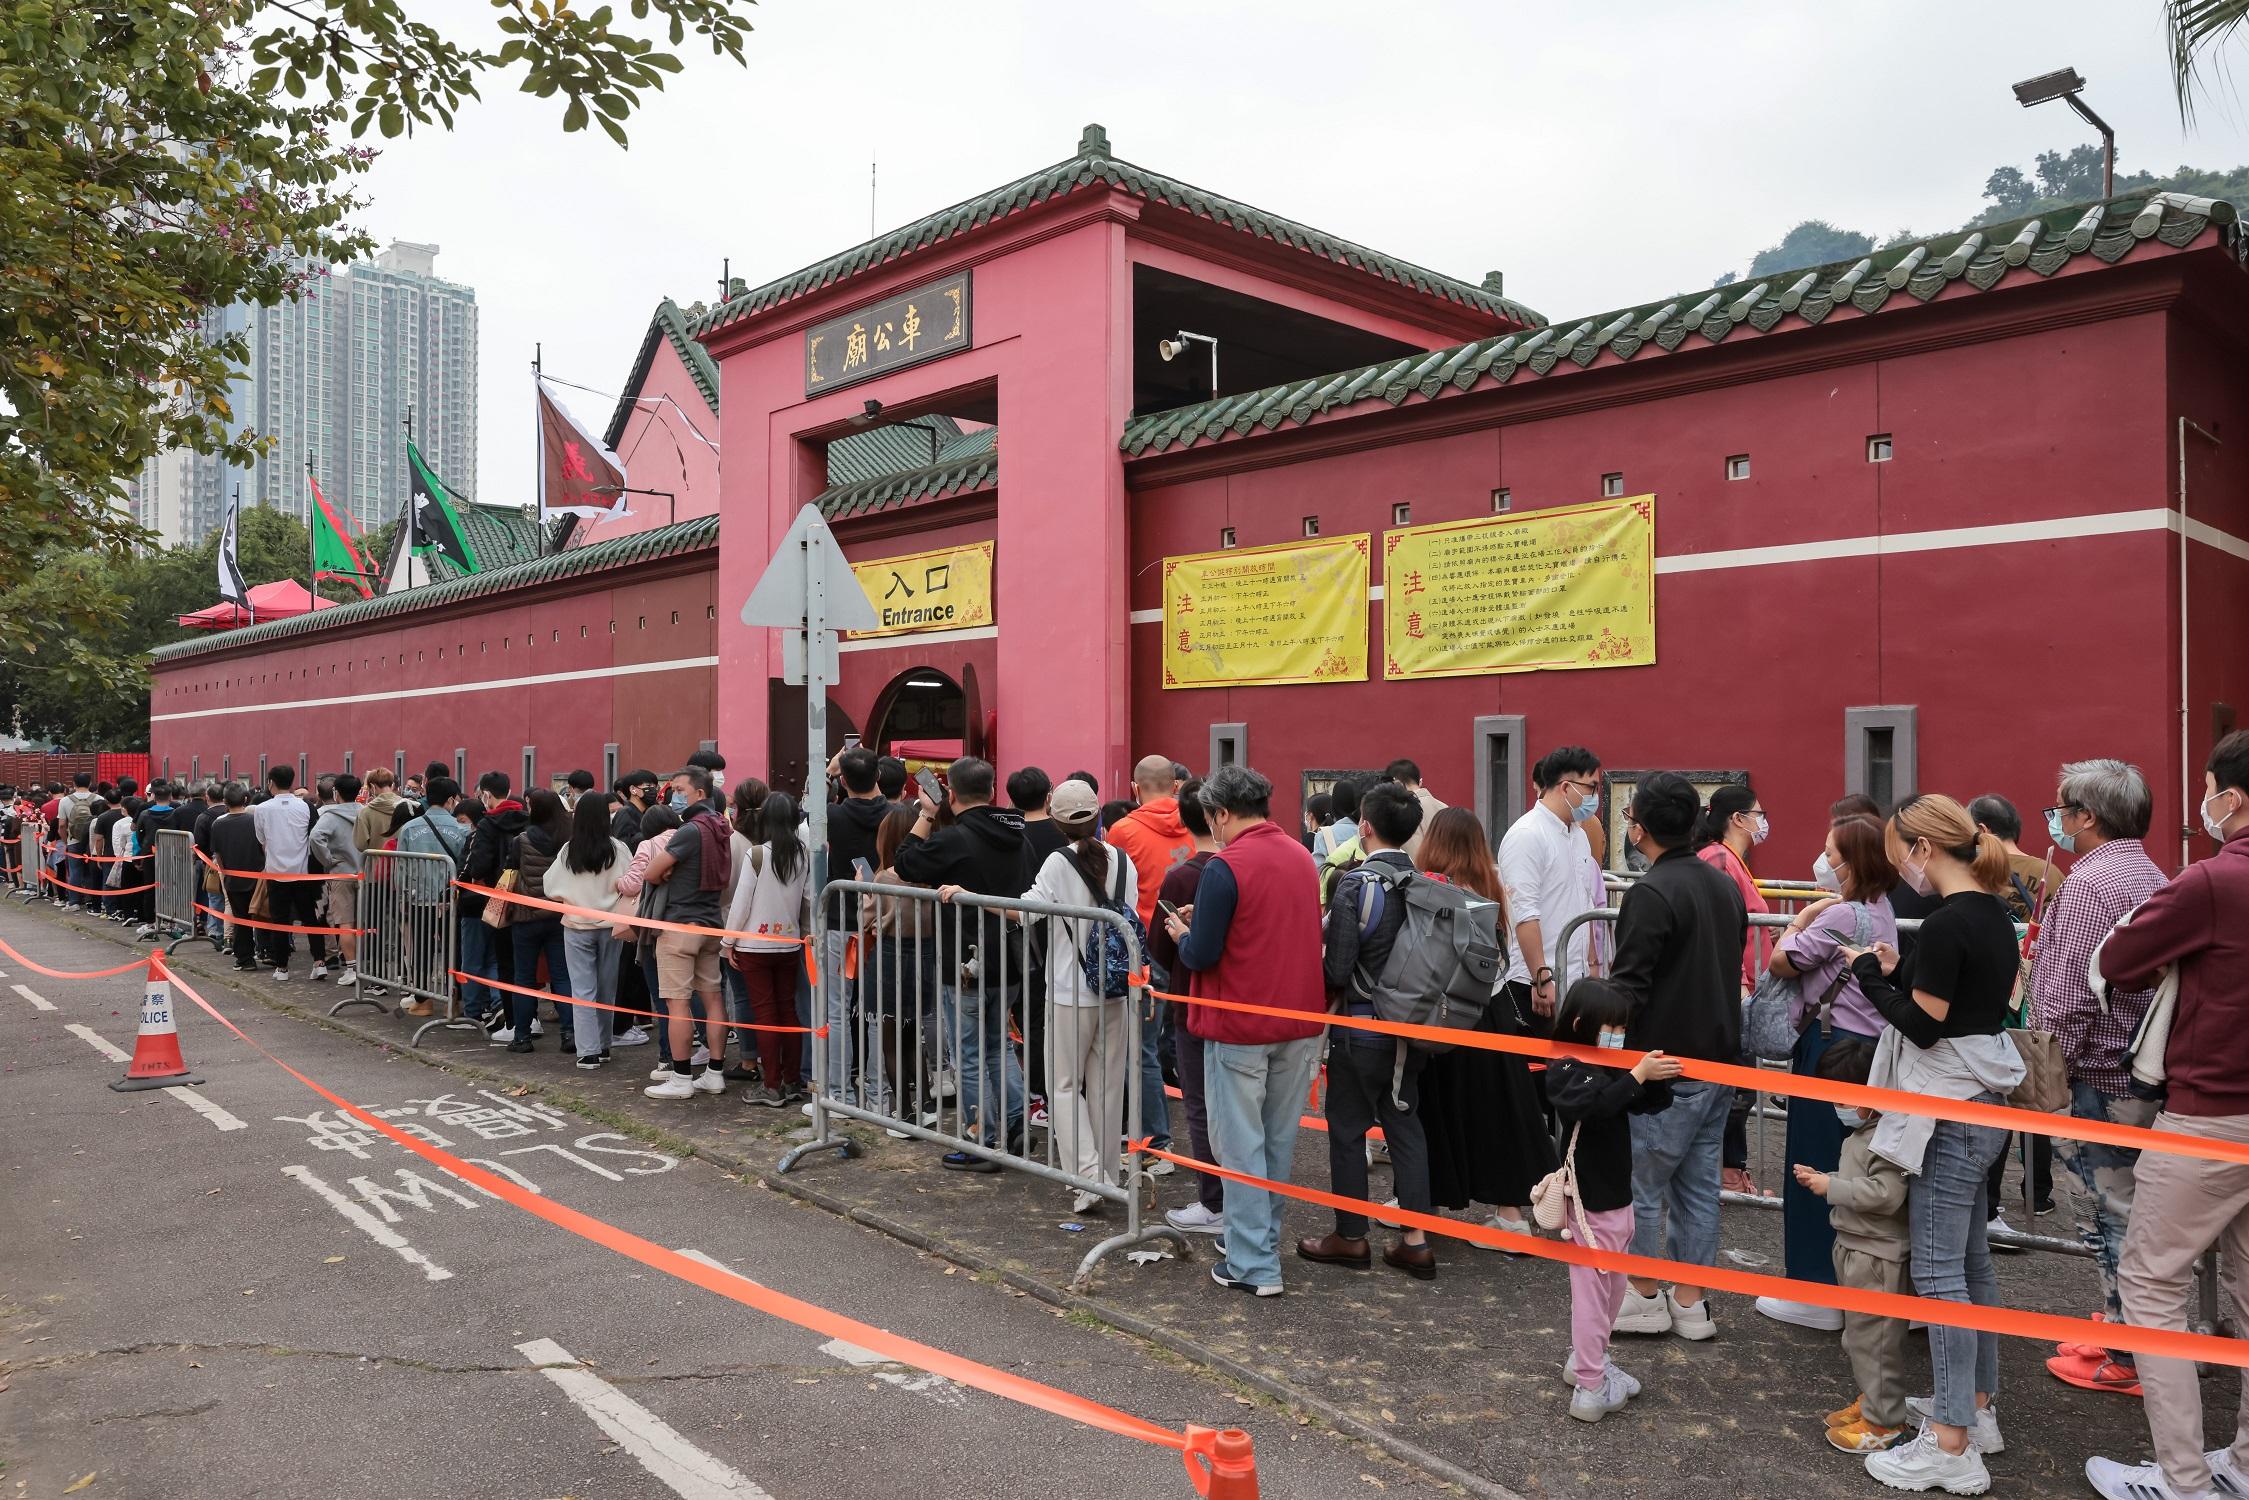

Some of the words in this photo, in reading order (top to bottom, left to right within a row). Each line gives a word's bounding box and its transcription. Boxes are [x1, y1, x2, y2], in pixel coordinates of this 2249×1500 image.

[843, 304, 921, 372] 車公廟
[885, 565, 949, 600] 入口
[1403, 570, 1425, 639] 注意
[883, 604, 954, 626] Entrance
[1177, 593, 1195, 654] 注意
[346, 1132, 680, 1223] SLOW
